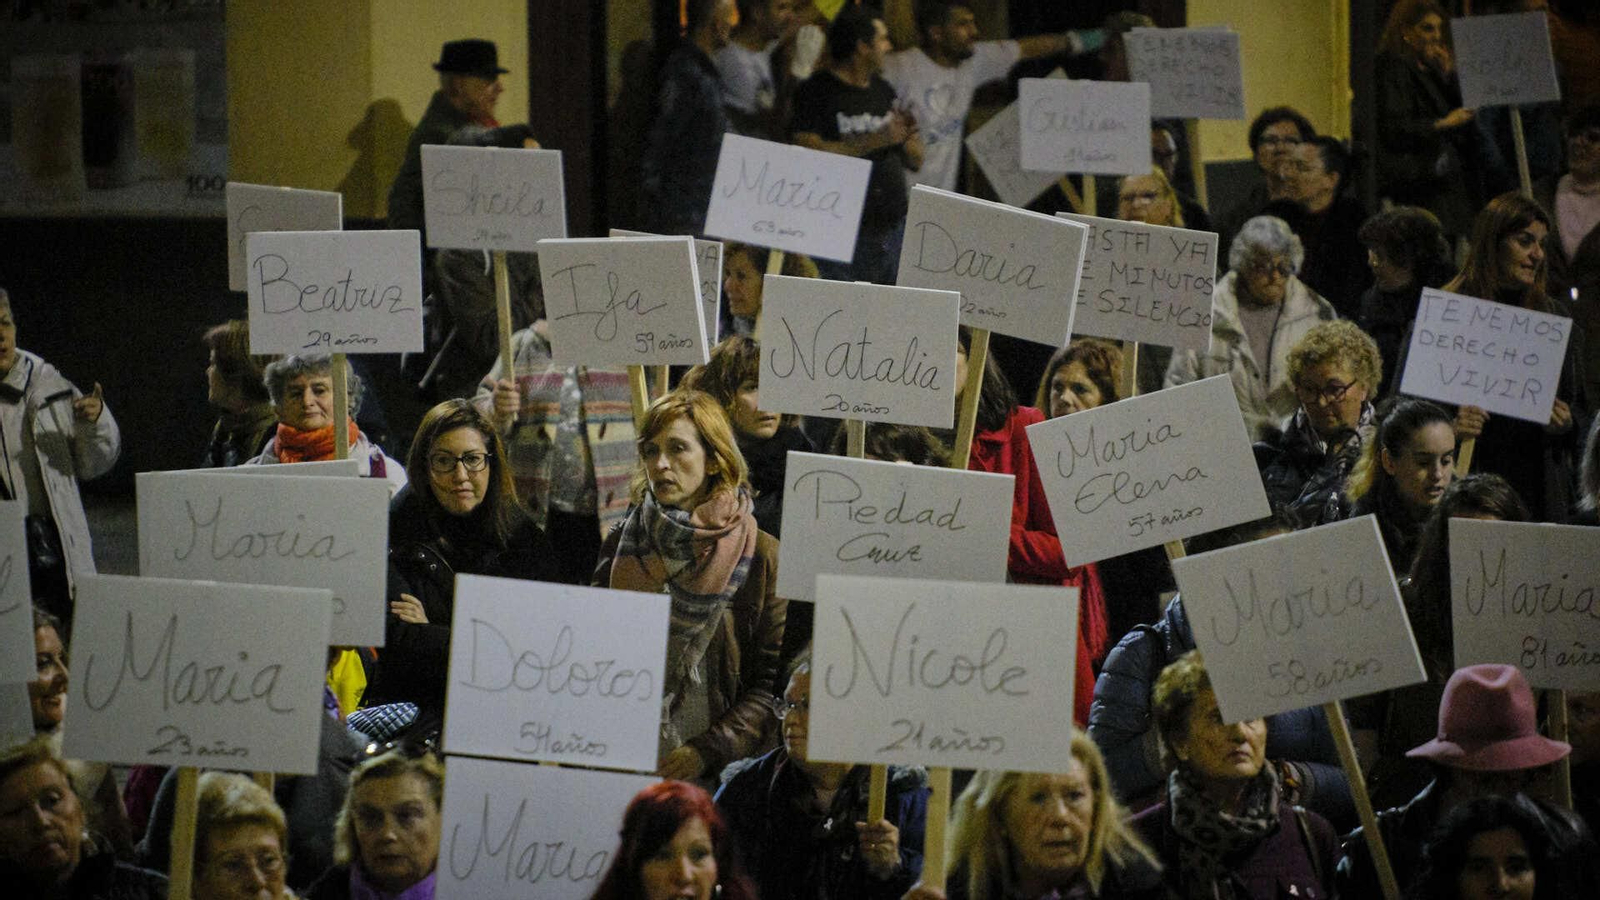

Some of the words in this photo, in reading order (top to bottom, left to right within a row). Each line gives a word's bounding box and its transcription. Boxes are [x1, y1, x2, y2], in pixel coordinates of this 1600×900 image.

[432, 168, 552, 218] Sheila
[723, 157, 844, 219] Maria
[913, 221, 1046, 291] Daria
[1088, 225, 1150, 252] ASTA
[1169, 236, 1209, 264] YA
[253, 253, 415, 314] Beatriz
[1109, 260, 1214, 296] MINUTOS
[552, 264, 667, 342] Ifa
[1099, 289, 1212, 328] SILENCIO
[1423, 295, 1563, 343] TENEMOS
[302, 330, 331, 348] 29
[334, 333, 378, 346] años
[635, 331, 655, 354] 59
[658, 335, 694, 351] años
[770, 309, 940, 391] Natalia
[1419, 329, 1539, 366] DERECHO
[821, 393, 849, 414] 20
[852, 402, 890, 415] años
[1439, 362, 1543, 405] VIVIR
[1057, 418, 1181, 478] Maria
[793, 469, 966, 531] Piedad
[1075, 466, 1208, 514] Elena
[175, 496, 355, 562] Maria
[1128, 513, 1155, 537] 57
[1161, 506, 1203, 524] años
[836, 532, 922, 564] Cruz
[1210, 567, 1382, 647] Maria
[1466, 548, 1600, 619] Maria
[83, 610, 295, 713] Maria
[459, 618, 653, 701] Dolores
[825, 601, 1030, 699] Nicole
[1520, 636, 1548, 669] 81
[1555, 641, 1600, 666] año
[1266, 661, 1310, 698] 58
[1314, 655, 1382, 689] años
[148, 724, 192, 756] 23
[197, 740, 249, 758] años
[551, 733, 606, 756] años
[881, 718, 925, 751] 21
[929, 727, 1005, 755] años
[452, 792, 610, 884] Maria
